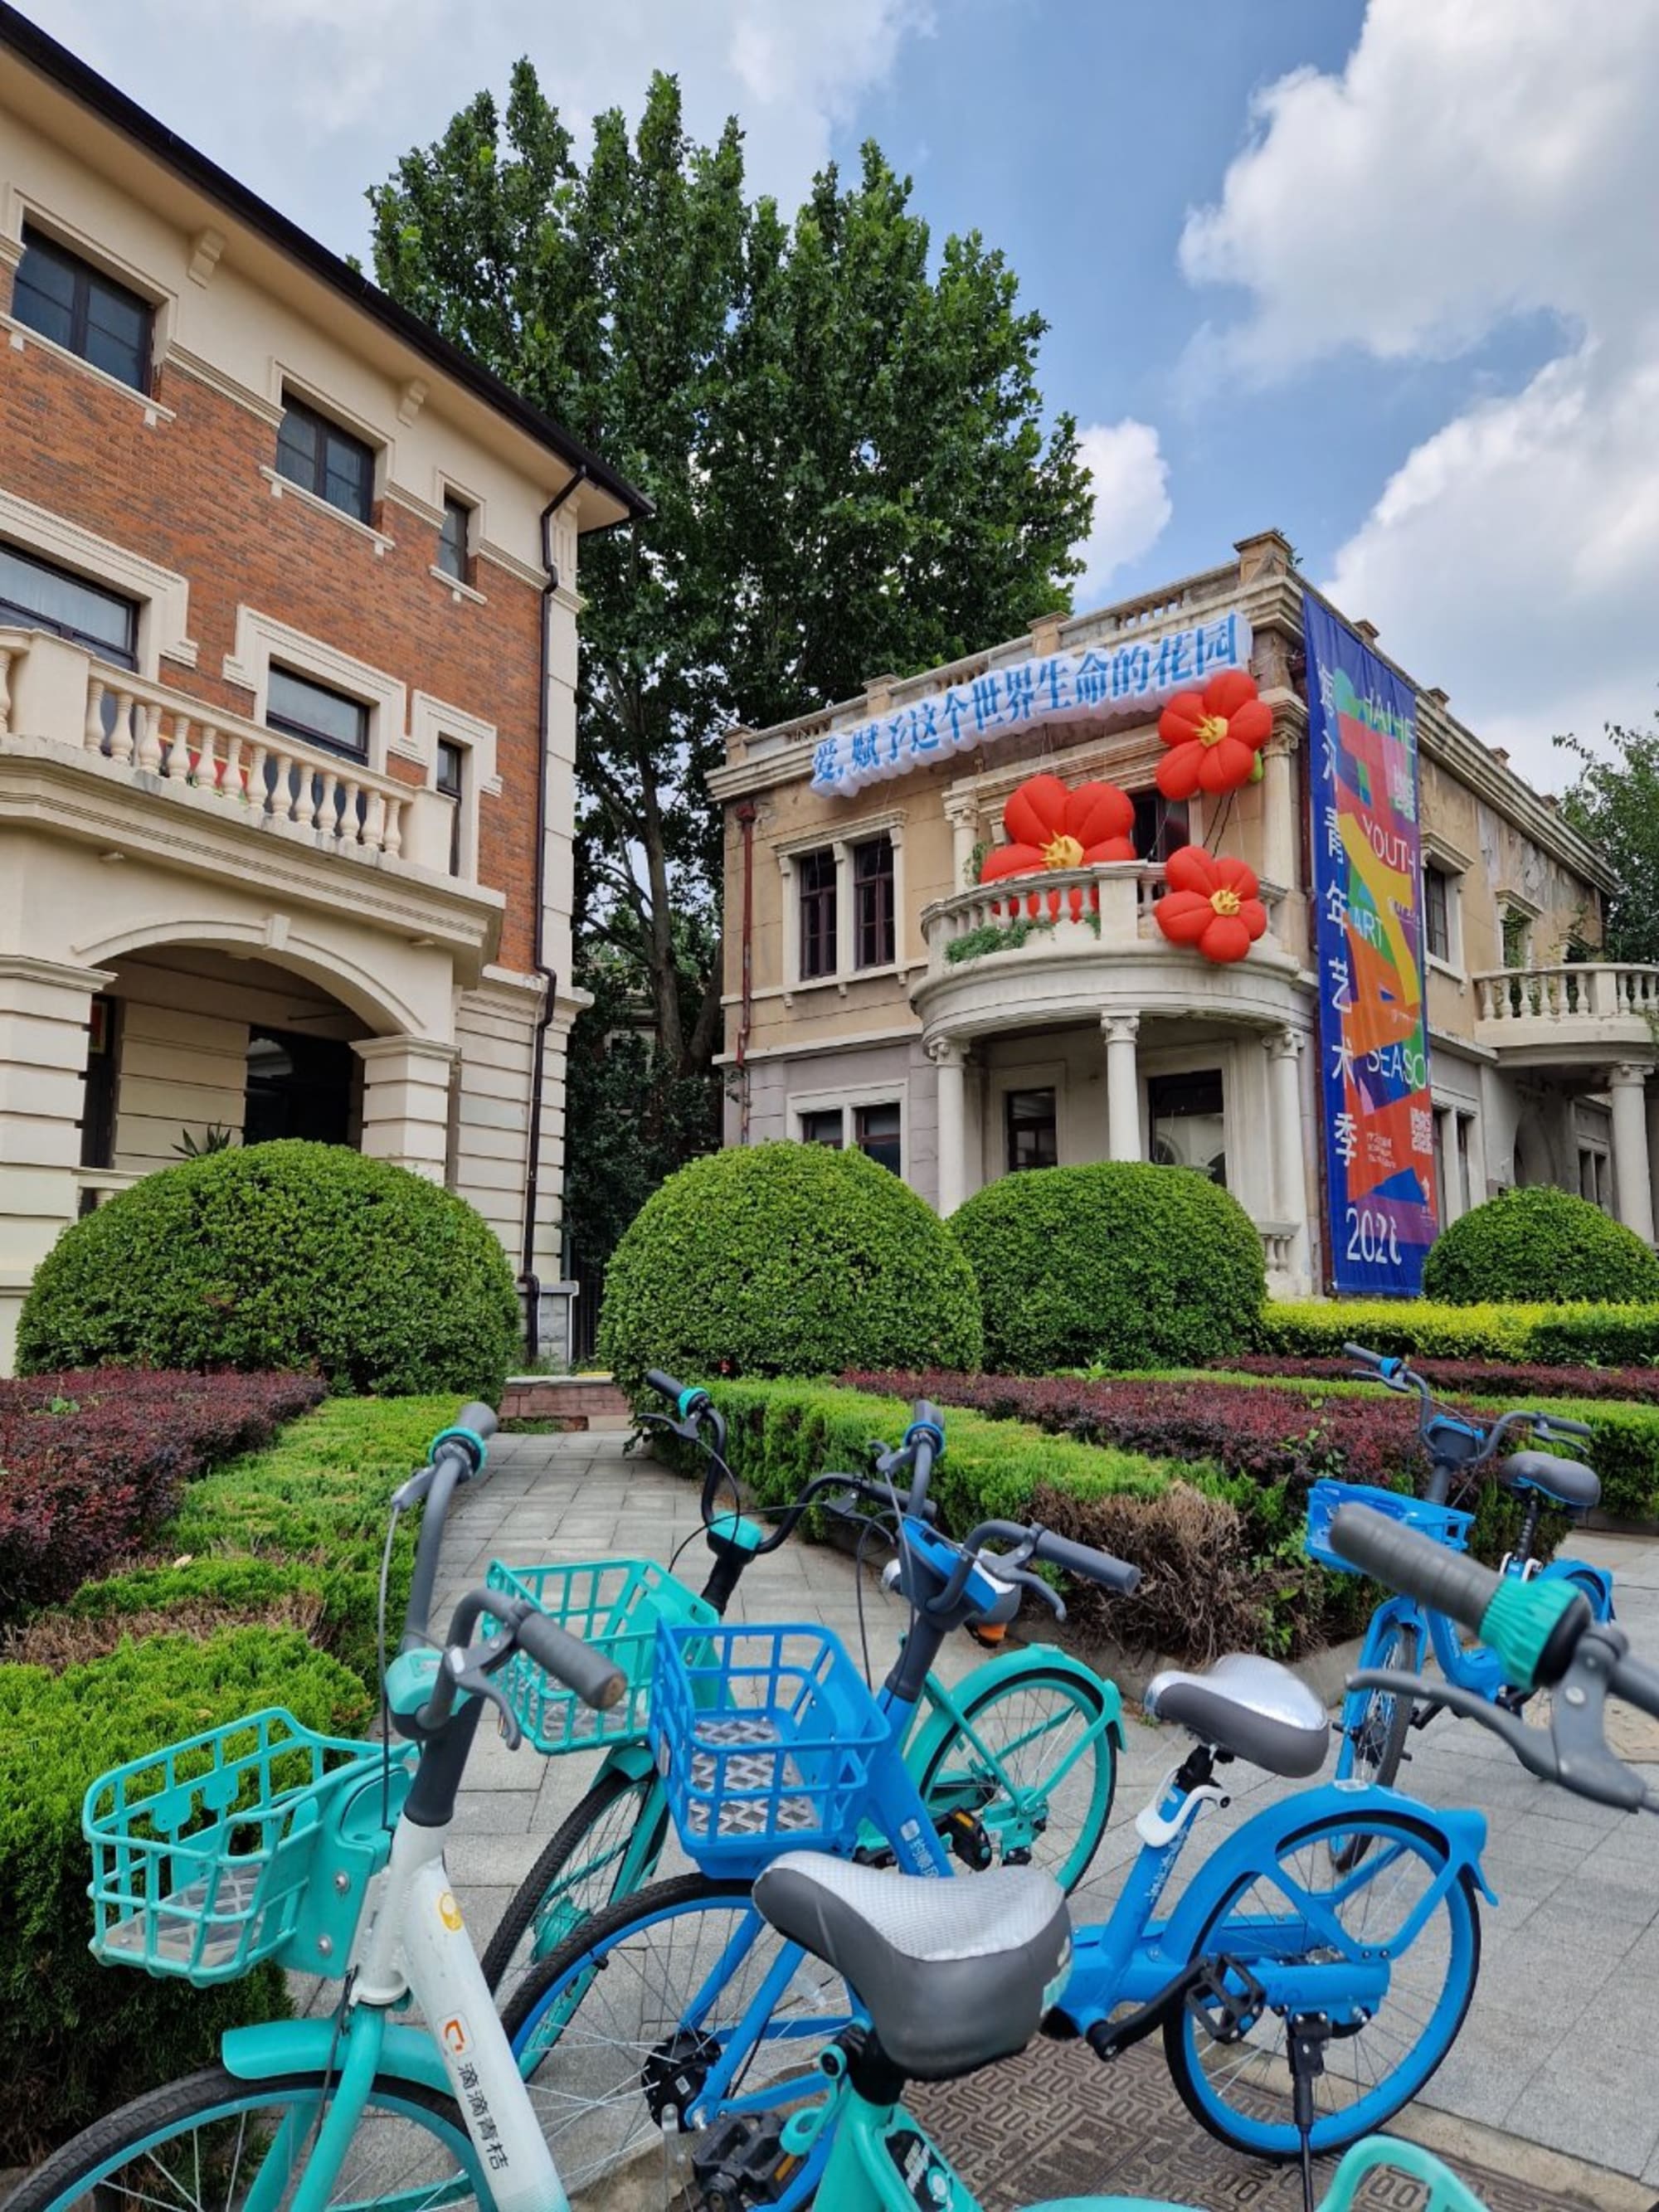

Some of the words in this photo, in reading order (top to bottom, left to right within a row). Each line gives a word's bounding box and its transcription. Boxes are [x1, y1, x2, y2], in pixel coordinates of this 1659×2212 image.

[1362, 814, 1416, 882] YOUTH
[1353, 906, 1383, 949] ART
[458, 2062, 509, 2170] 滴滴青桔
